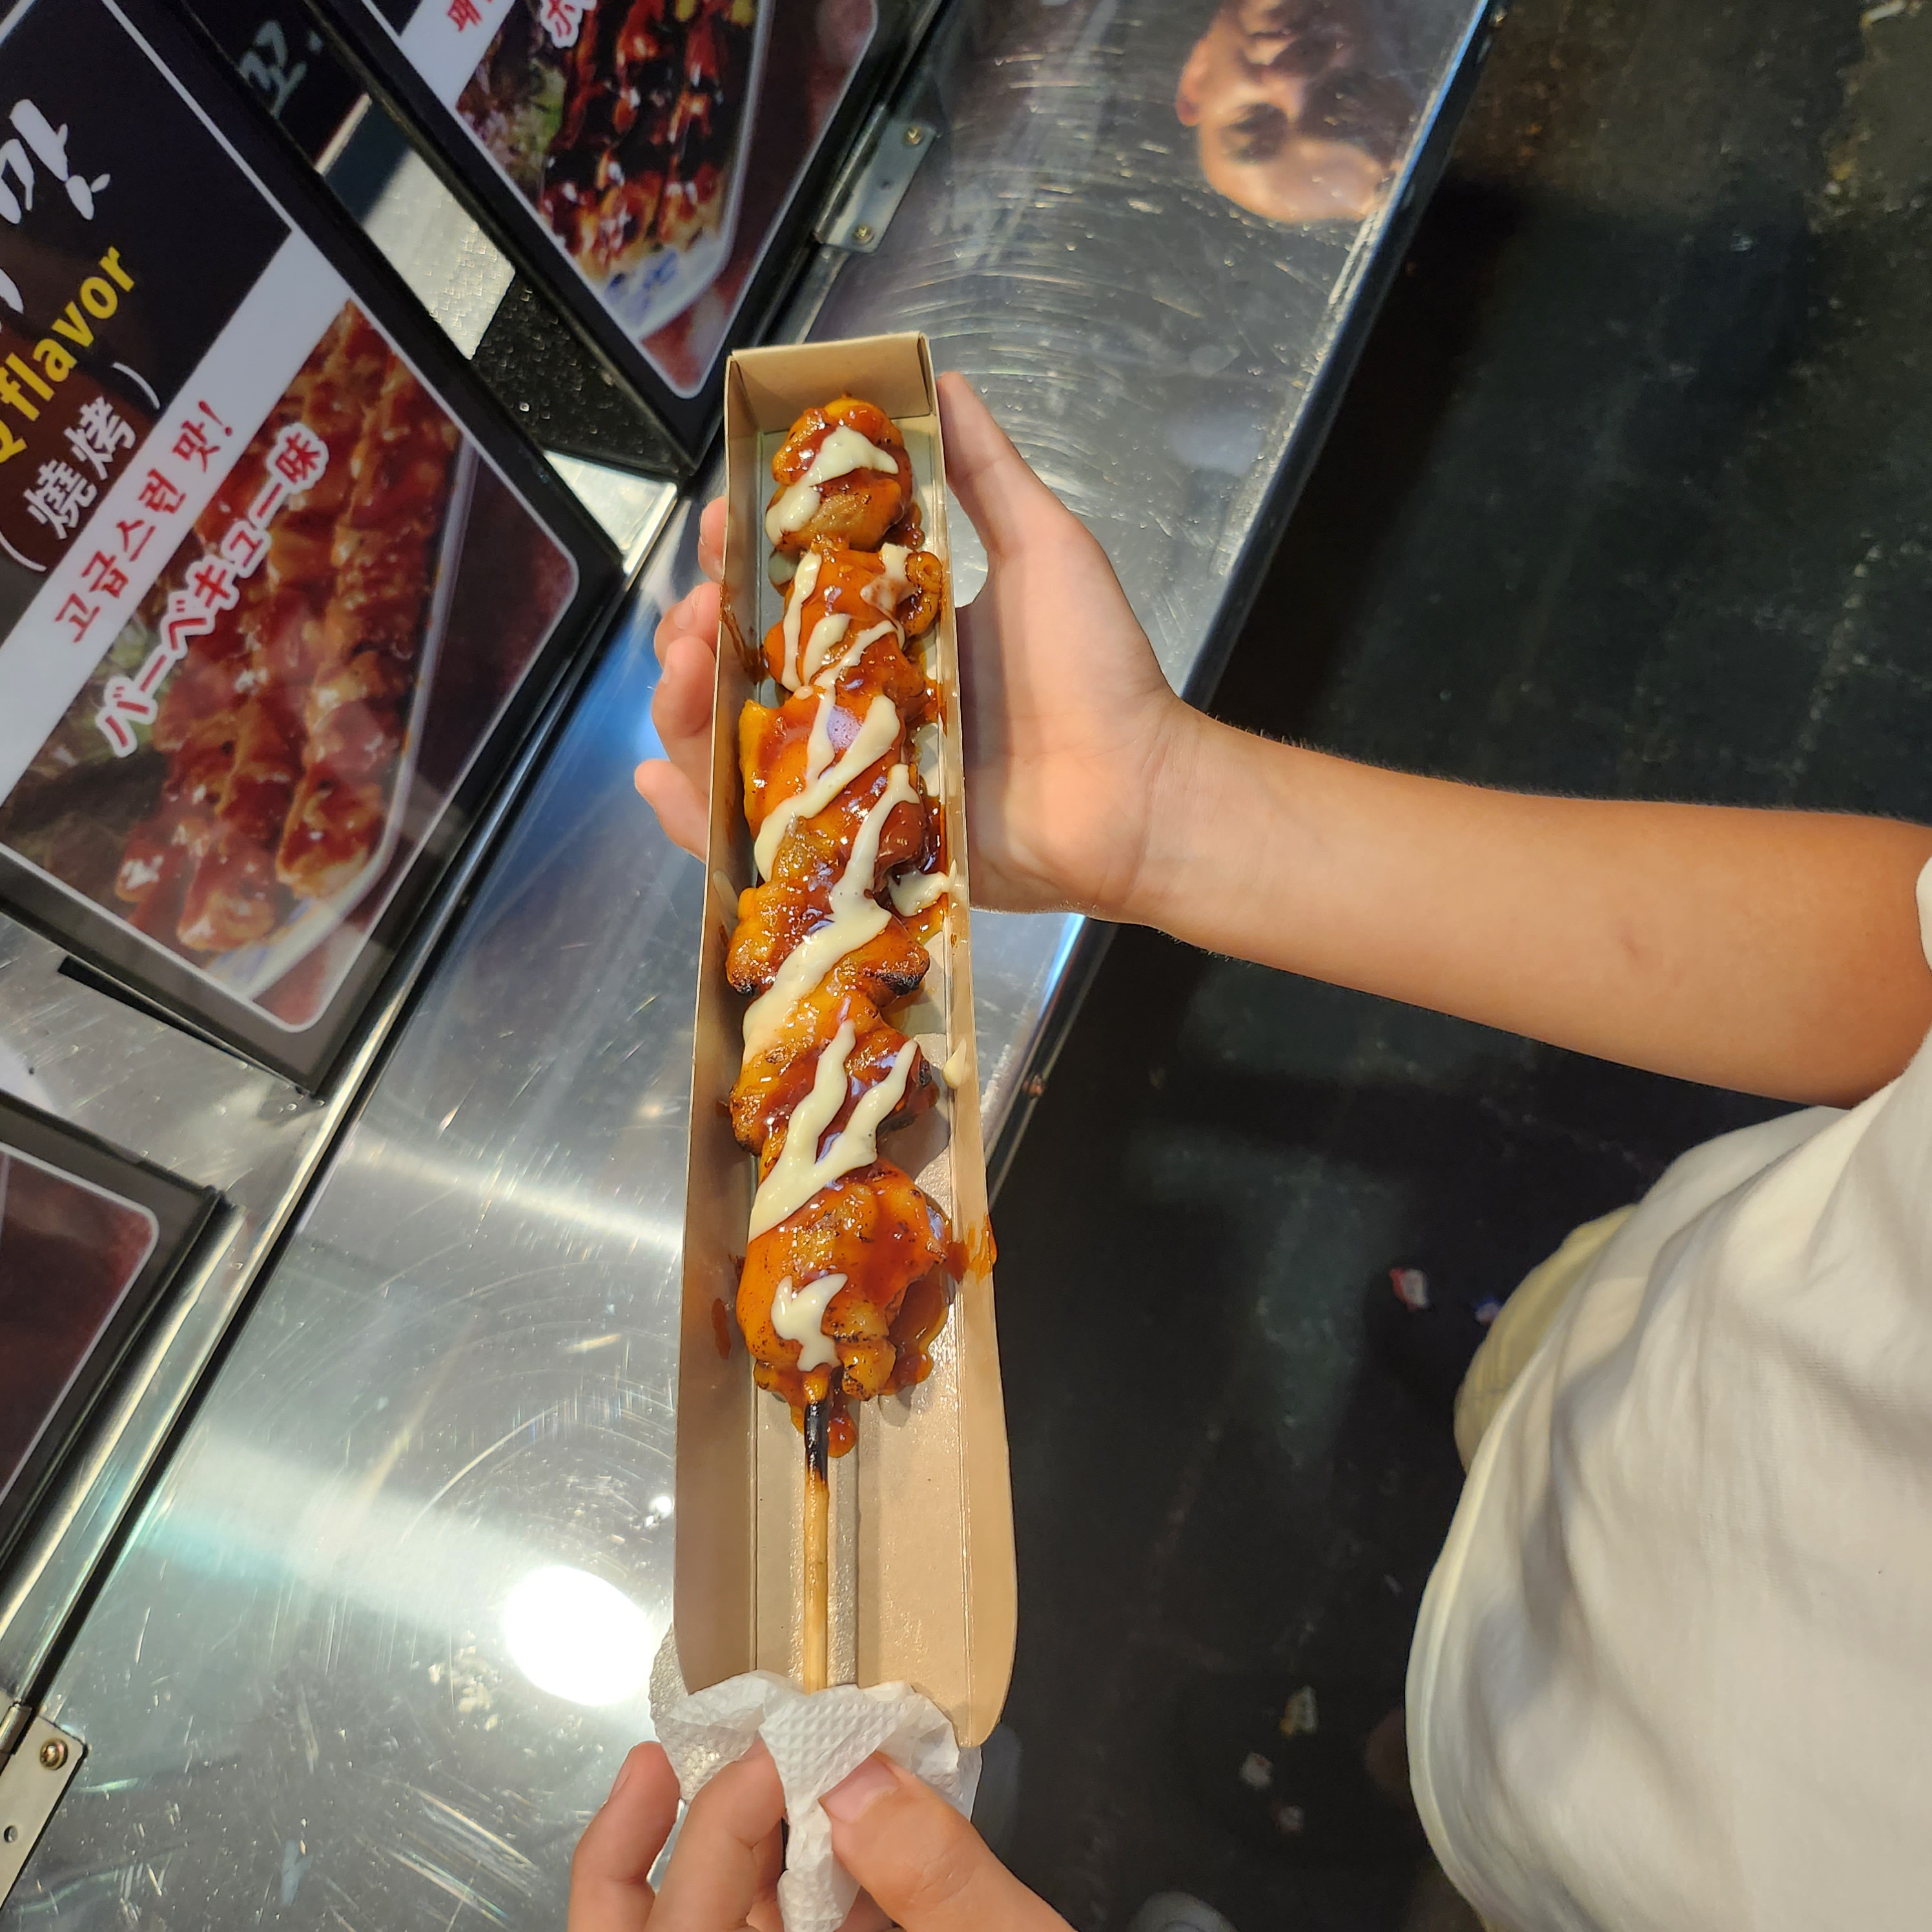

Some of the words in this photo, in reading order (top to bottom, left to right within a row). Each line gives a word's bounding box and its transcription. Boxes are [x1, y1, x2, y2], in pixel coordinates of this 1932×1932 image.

[0, 245, 135, 422] flavor
[54, 468, 187, 643] 고급스런
[172, 400, 234, 473] 맛!
[101, 429, 324, 750] バーベキュー味
